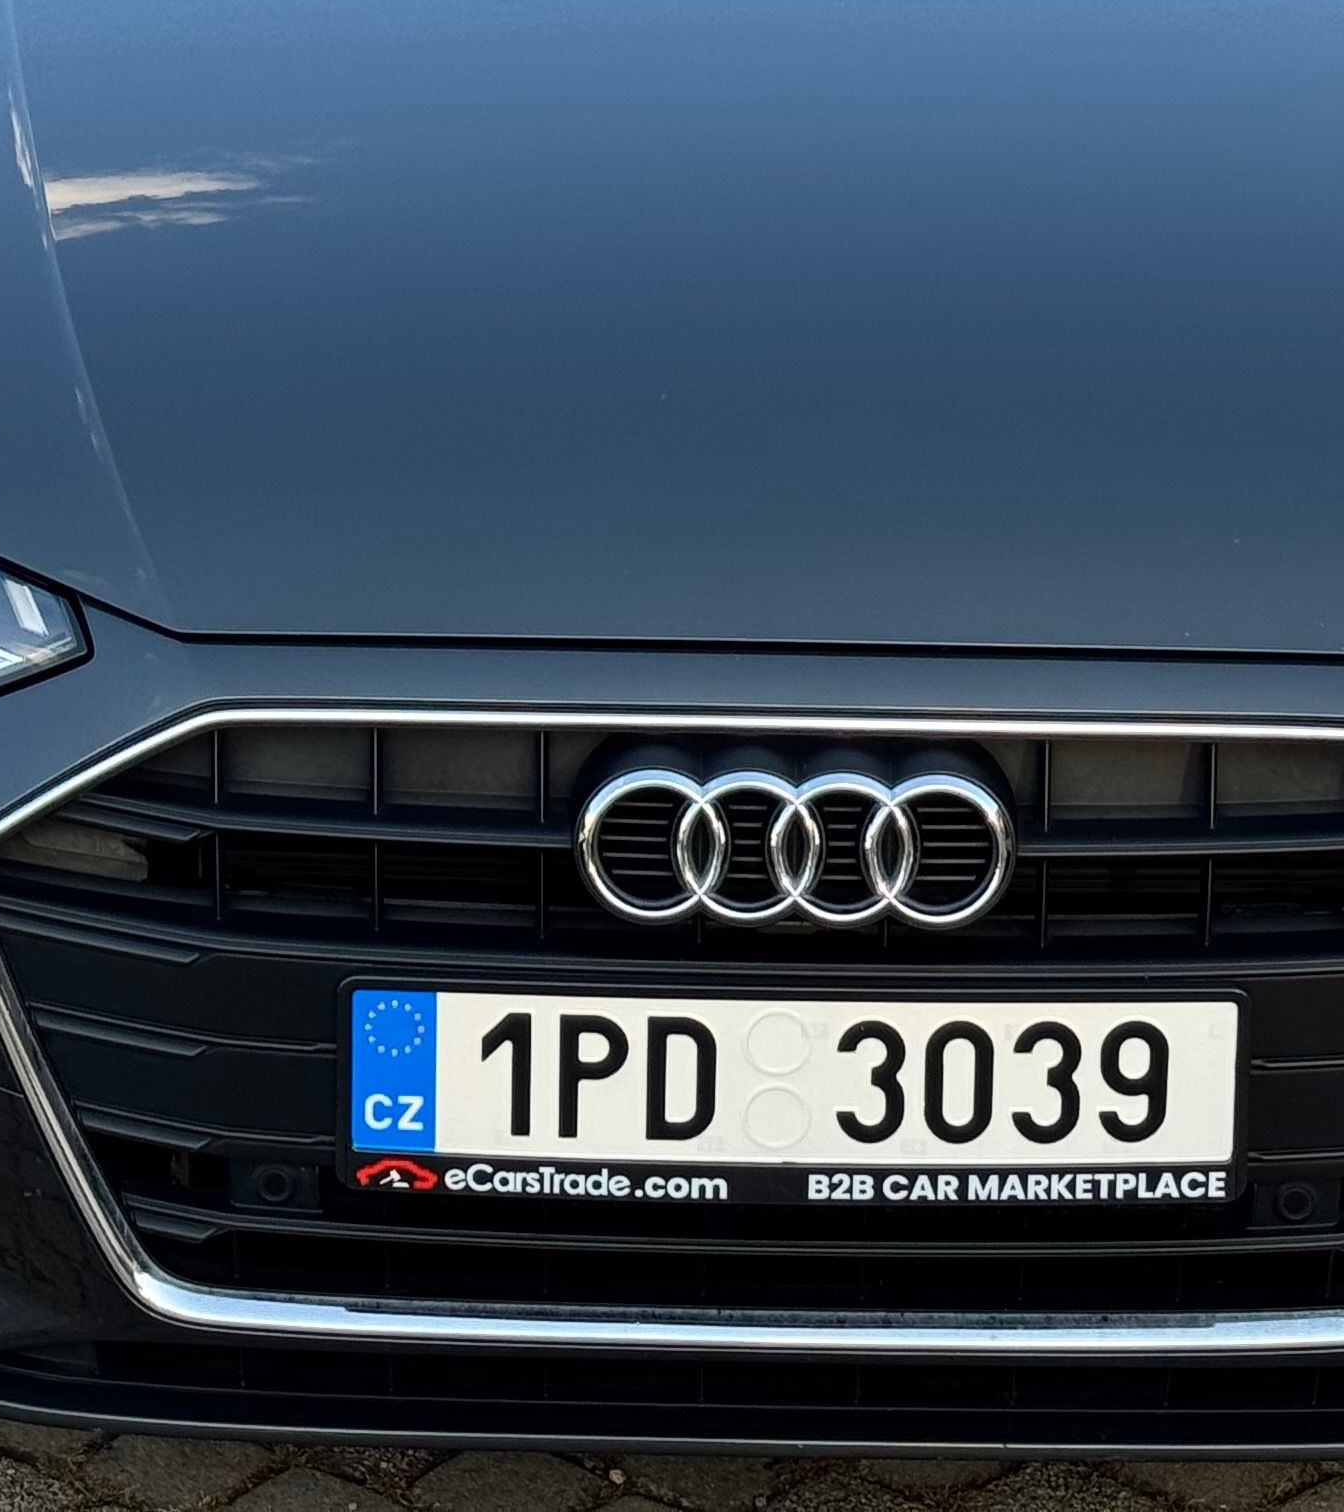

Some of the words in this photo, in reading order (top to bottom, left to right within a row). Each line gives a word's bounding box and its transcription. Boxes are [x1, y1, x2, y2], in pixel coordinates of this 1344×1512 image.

[364, 1094, 424, 1131] CZ
[481, 1012, 717, 1141] 1PD
[836, 1020, 1170, 1145] 3039
[444, 1163, 729, 1200] eCarsTrade.com
[808, 1173, 874, 1200] B2B
[882, 1173, 959, 1200] CAR
[968, 1171, 1227, 1200] MARKETPLACE
